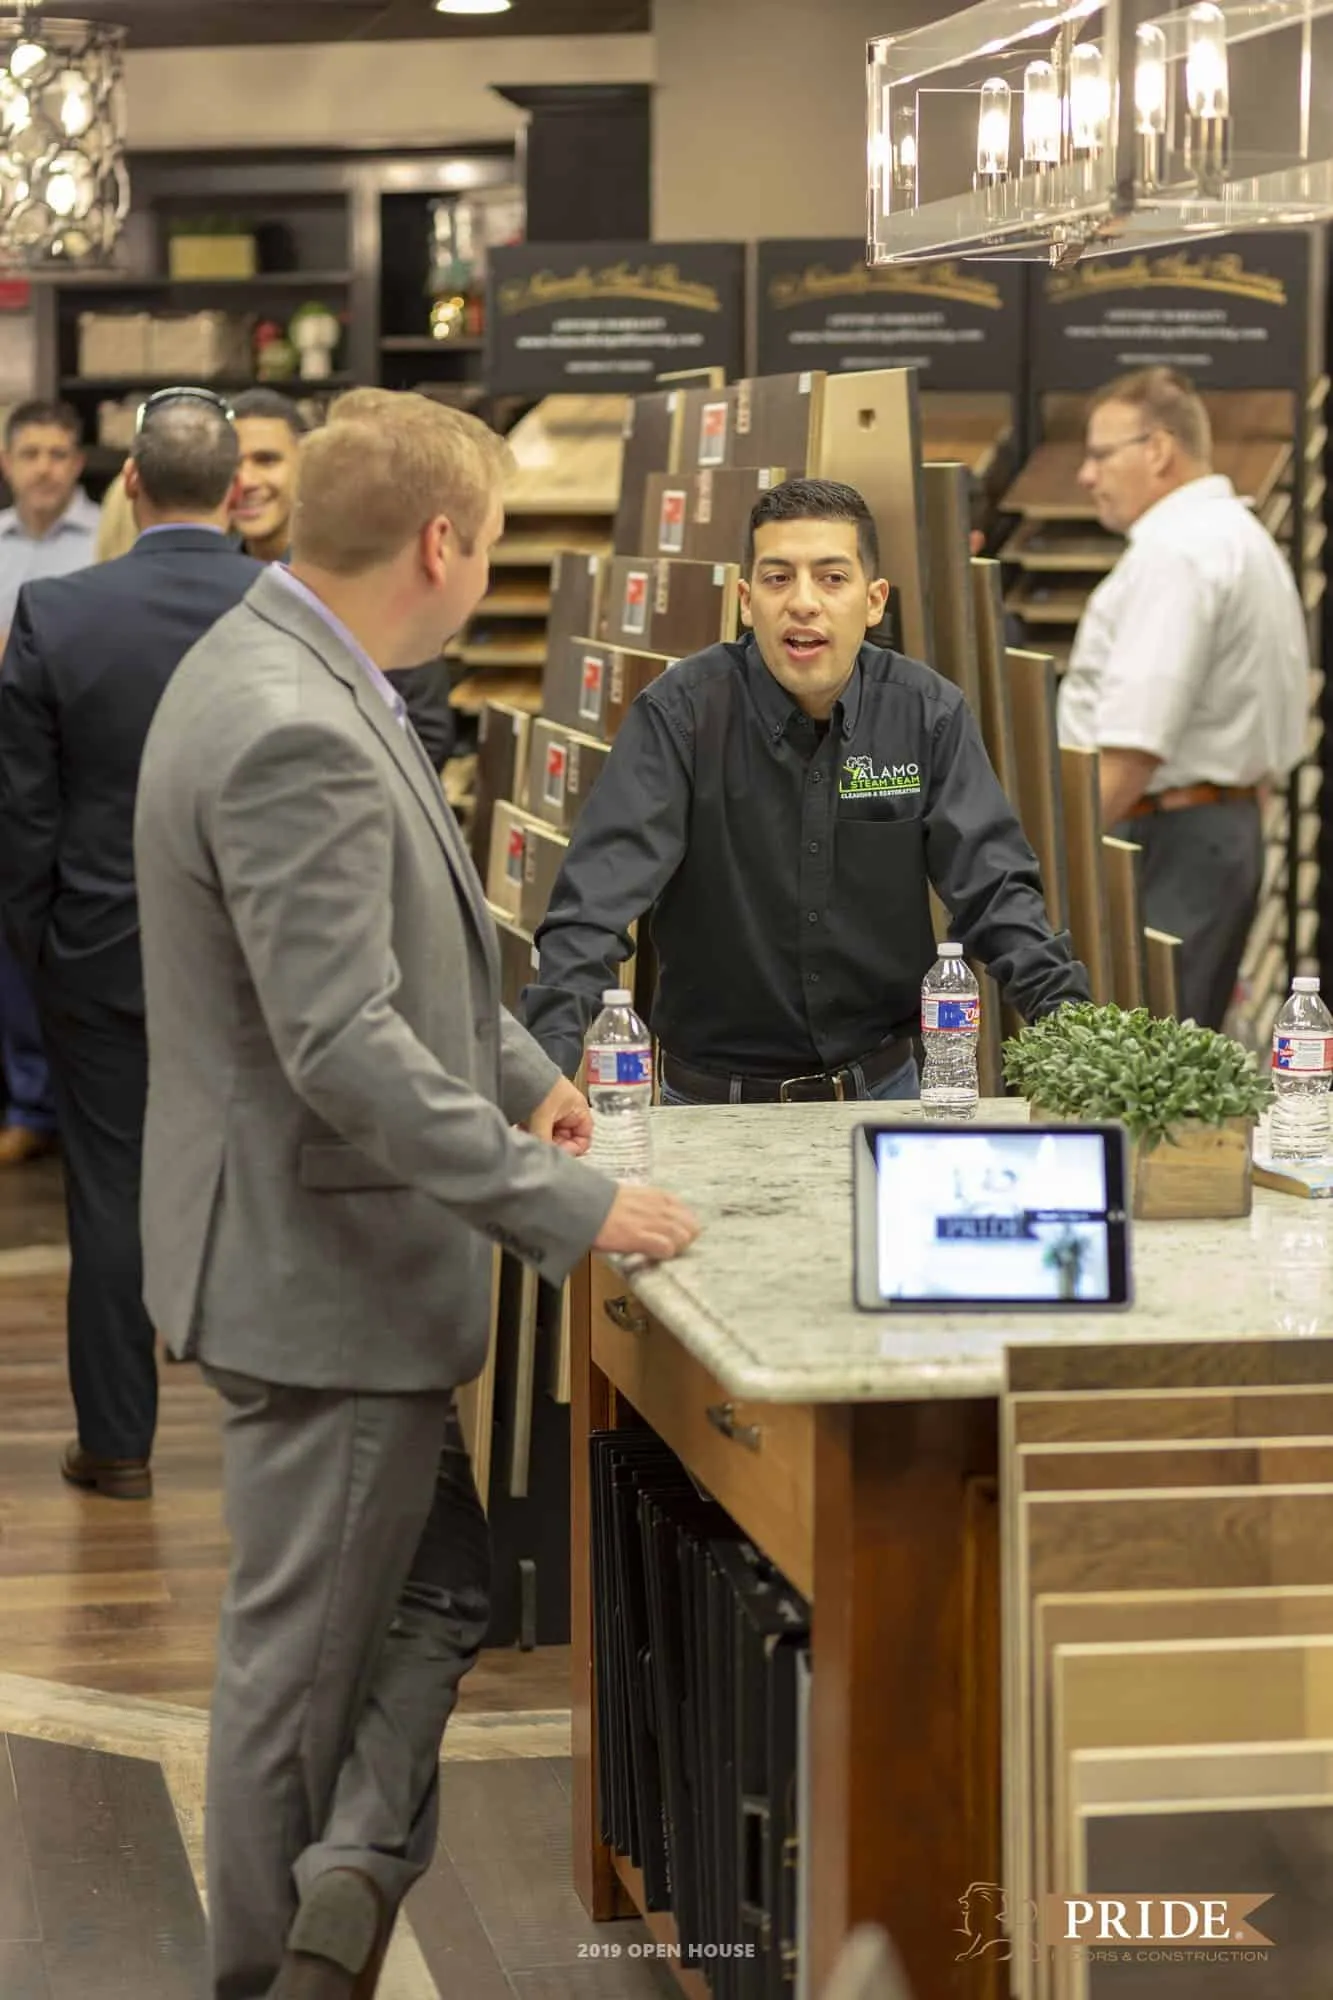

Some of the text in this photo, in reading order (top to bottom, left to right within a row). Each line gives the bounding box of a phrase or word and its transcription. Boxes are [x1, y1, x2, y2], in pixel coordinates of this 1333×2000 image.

[858, 763, 919, 780] ALAMO
[850, 776, 920, 789] STEAM TEAM
